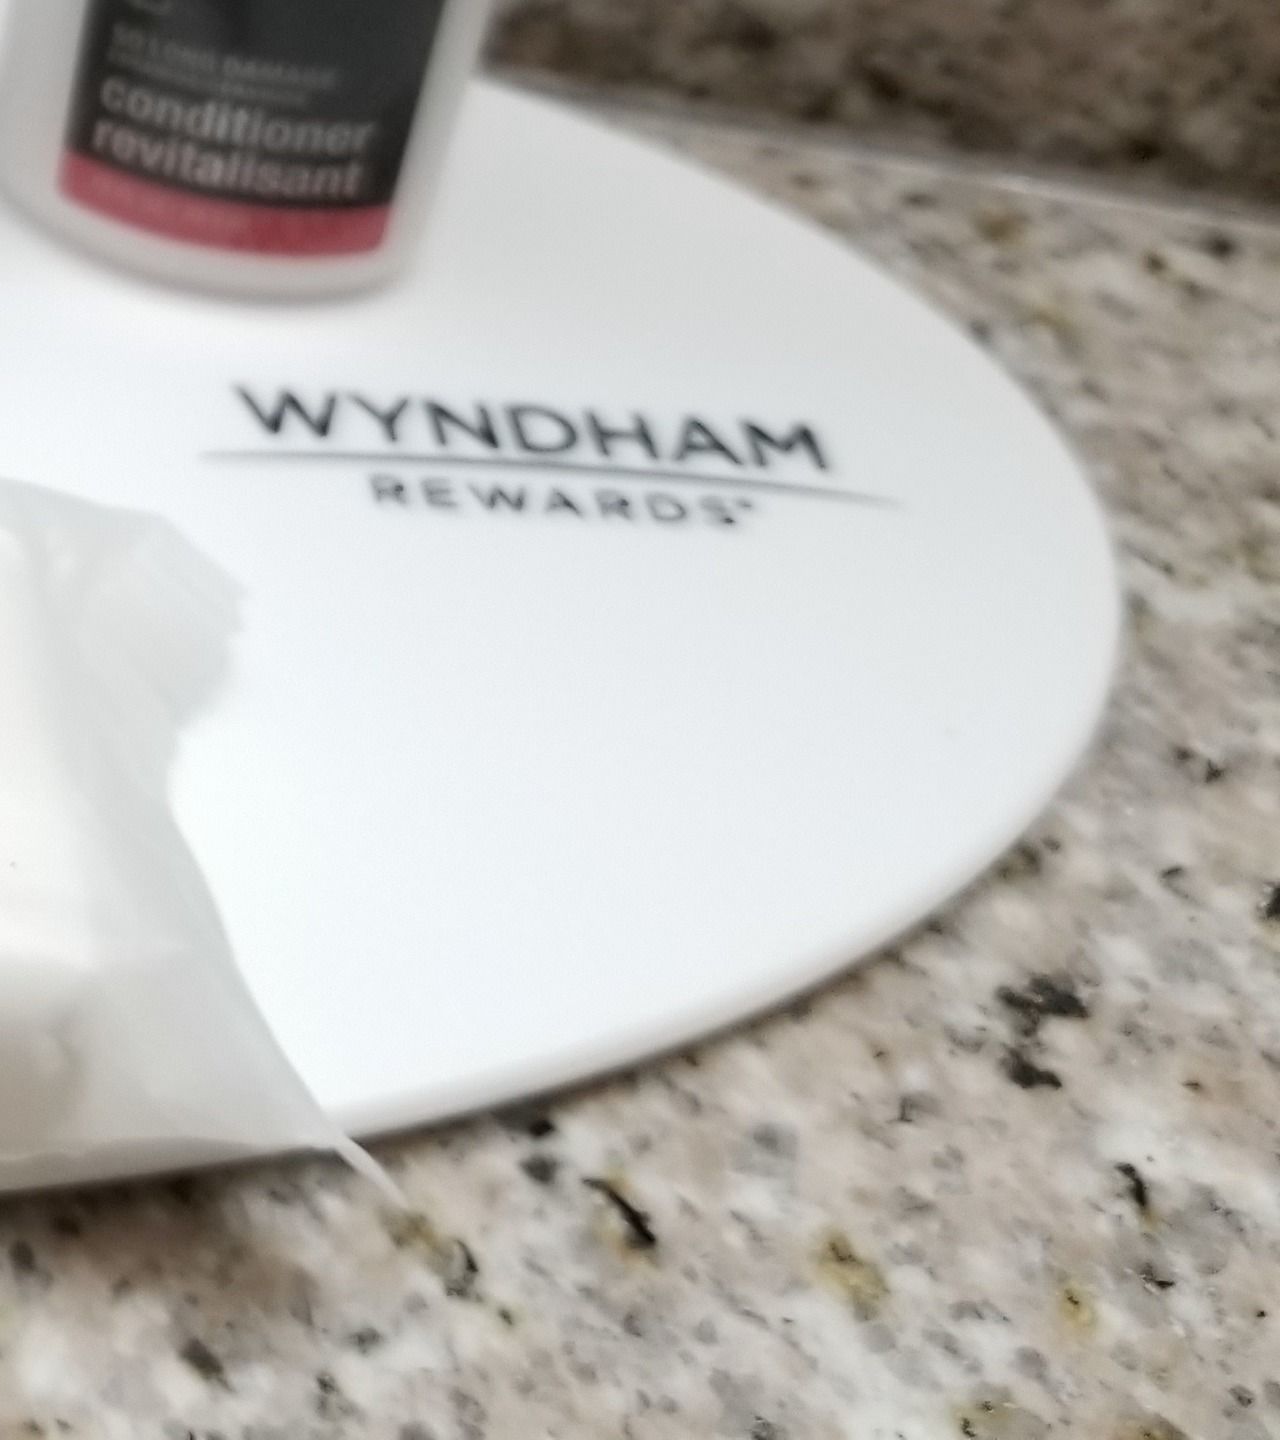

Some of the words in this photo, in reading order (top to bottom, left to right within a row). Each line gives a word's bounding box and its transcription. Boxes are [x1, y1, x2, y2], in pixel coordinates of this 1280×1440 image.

[99, 76, 377, 151] conditioner
[233, 382, 833, 471] WYNDHAM
[368, 472, 738, 526] REWARDS
